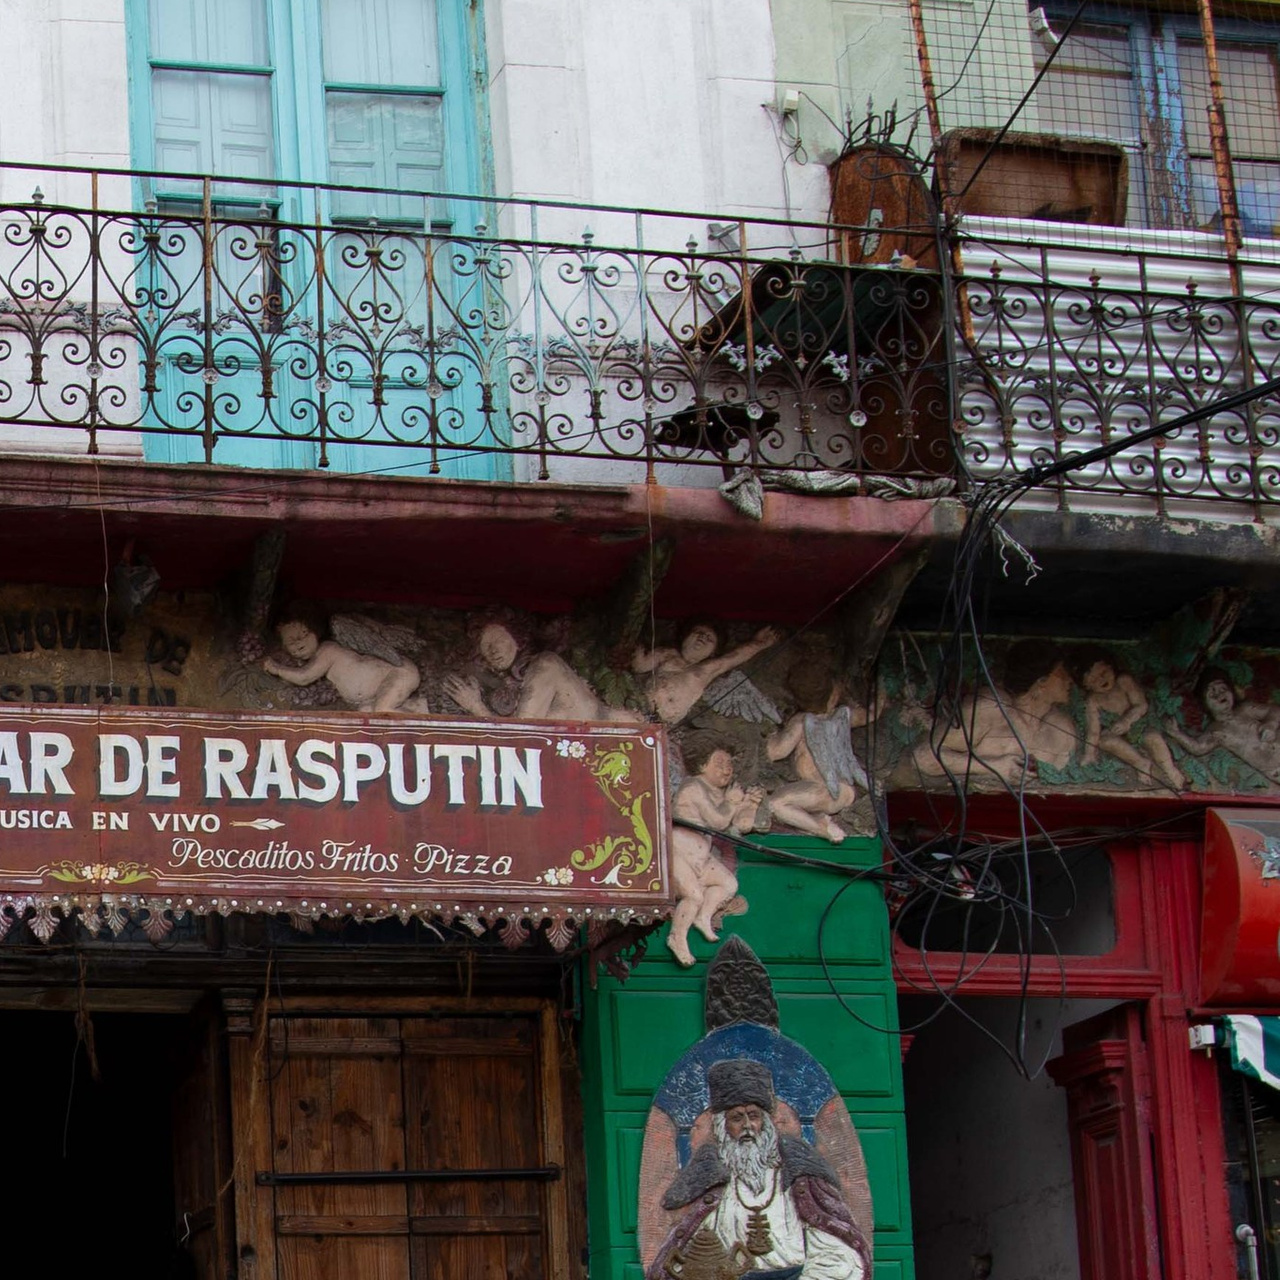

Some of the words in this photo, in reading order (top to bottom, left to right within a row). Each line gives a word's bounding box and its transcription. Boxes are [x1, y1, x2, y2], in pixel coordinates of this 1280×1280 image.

[99, 734, 182, 798] DE
[203, 737, 544, 809] RASPUTIN
[93, 812, 130, 831] EN
[149, 812, 221, 833] VIVO
[168, 837, 315, 872] Pescaditos
[319, 840, 399, 873] Fritos
[414, 843, 513, 876] Pizza
